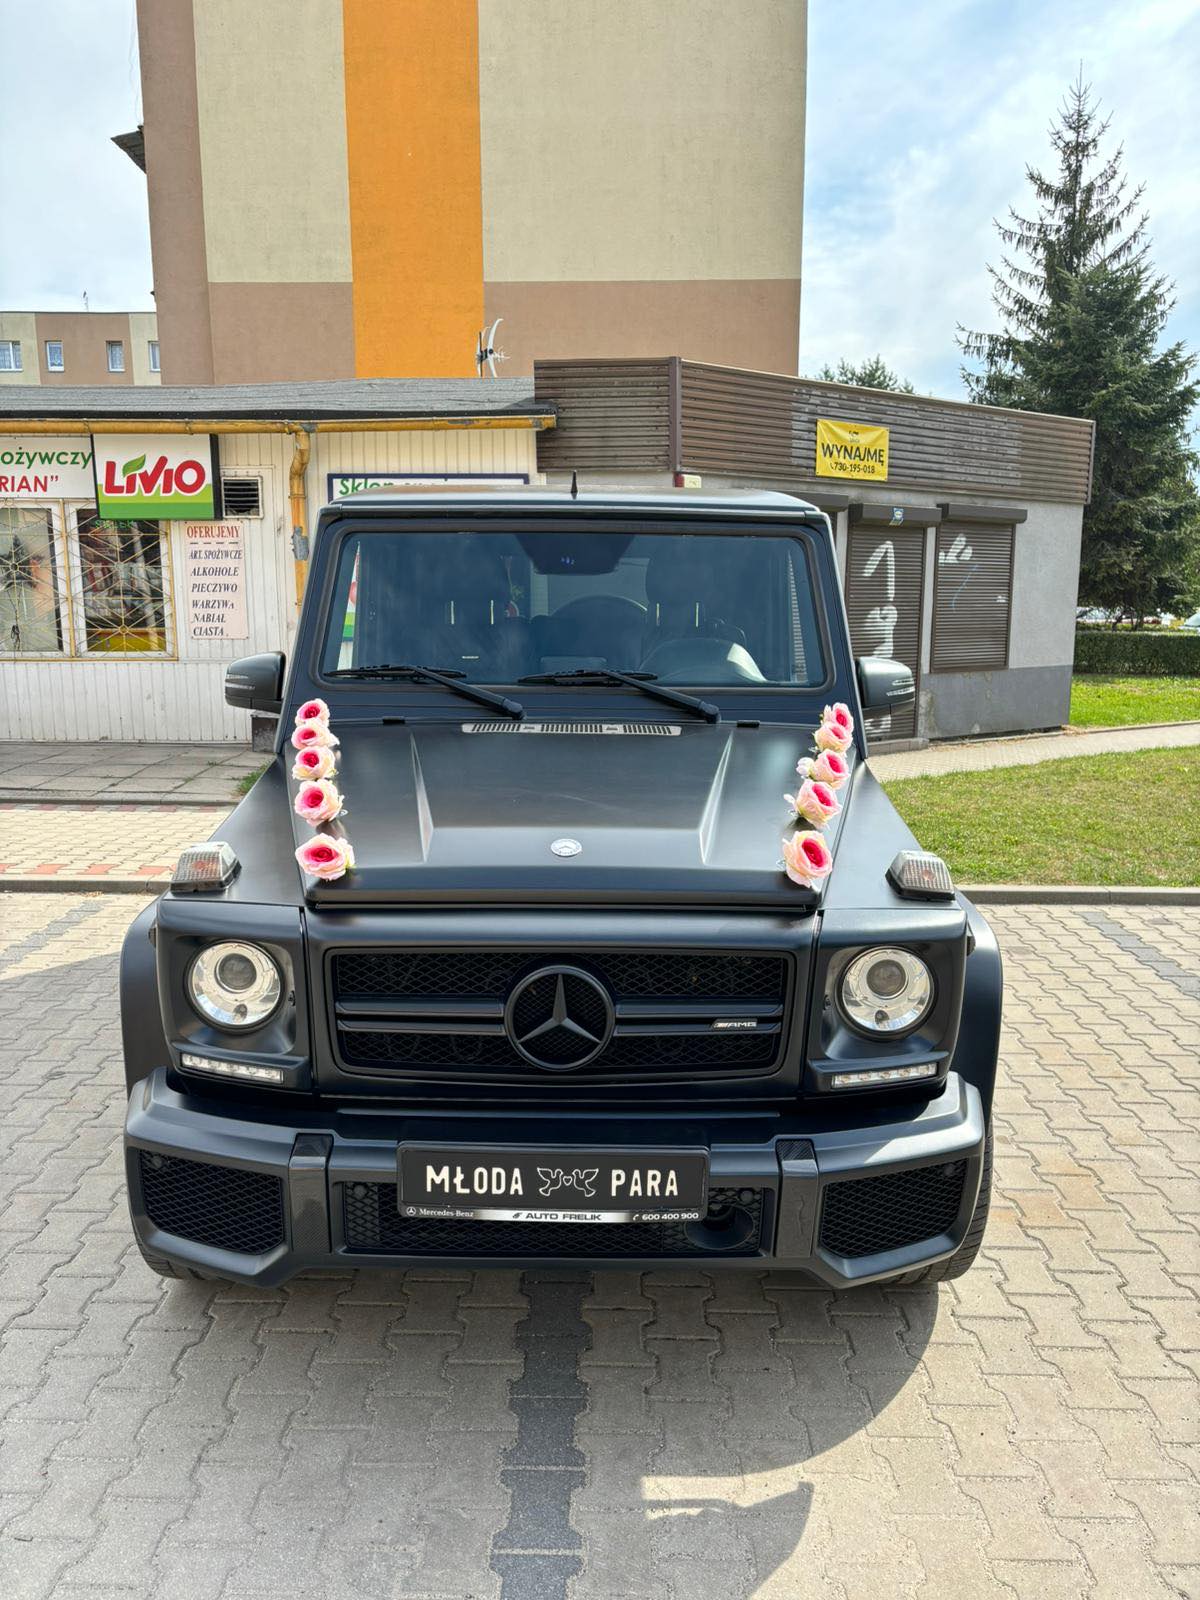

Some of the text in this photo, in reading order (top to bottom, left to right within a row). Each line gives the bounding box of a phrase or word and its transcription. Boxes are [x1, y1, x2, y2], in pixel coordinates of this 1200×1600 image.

[0, 447, 94, 469] ożywczy
[821, 442, 885, 466] WYNAJMĘ
[186, 525, 240, 538] OFERUJEMY
[191, 566, 239, 577] ALKOHOLE
[191, 583, 238, 593] PIECZYWO
[191, 600, 235, 609] WARZYWA
[193, 626, 224, 637] CIASTA
[425, 1164, 679, 1197] MŁODA PARA
[525, 1212, 602, 1221] AUTO FRELIK
